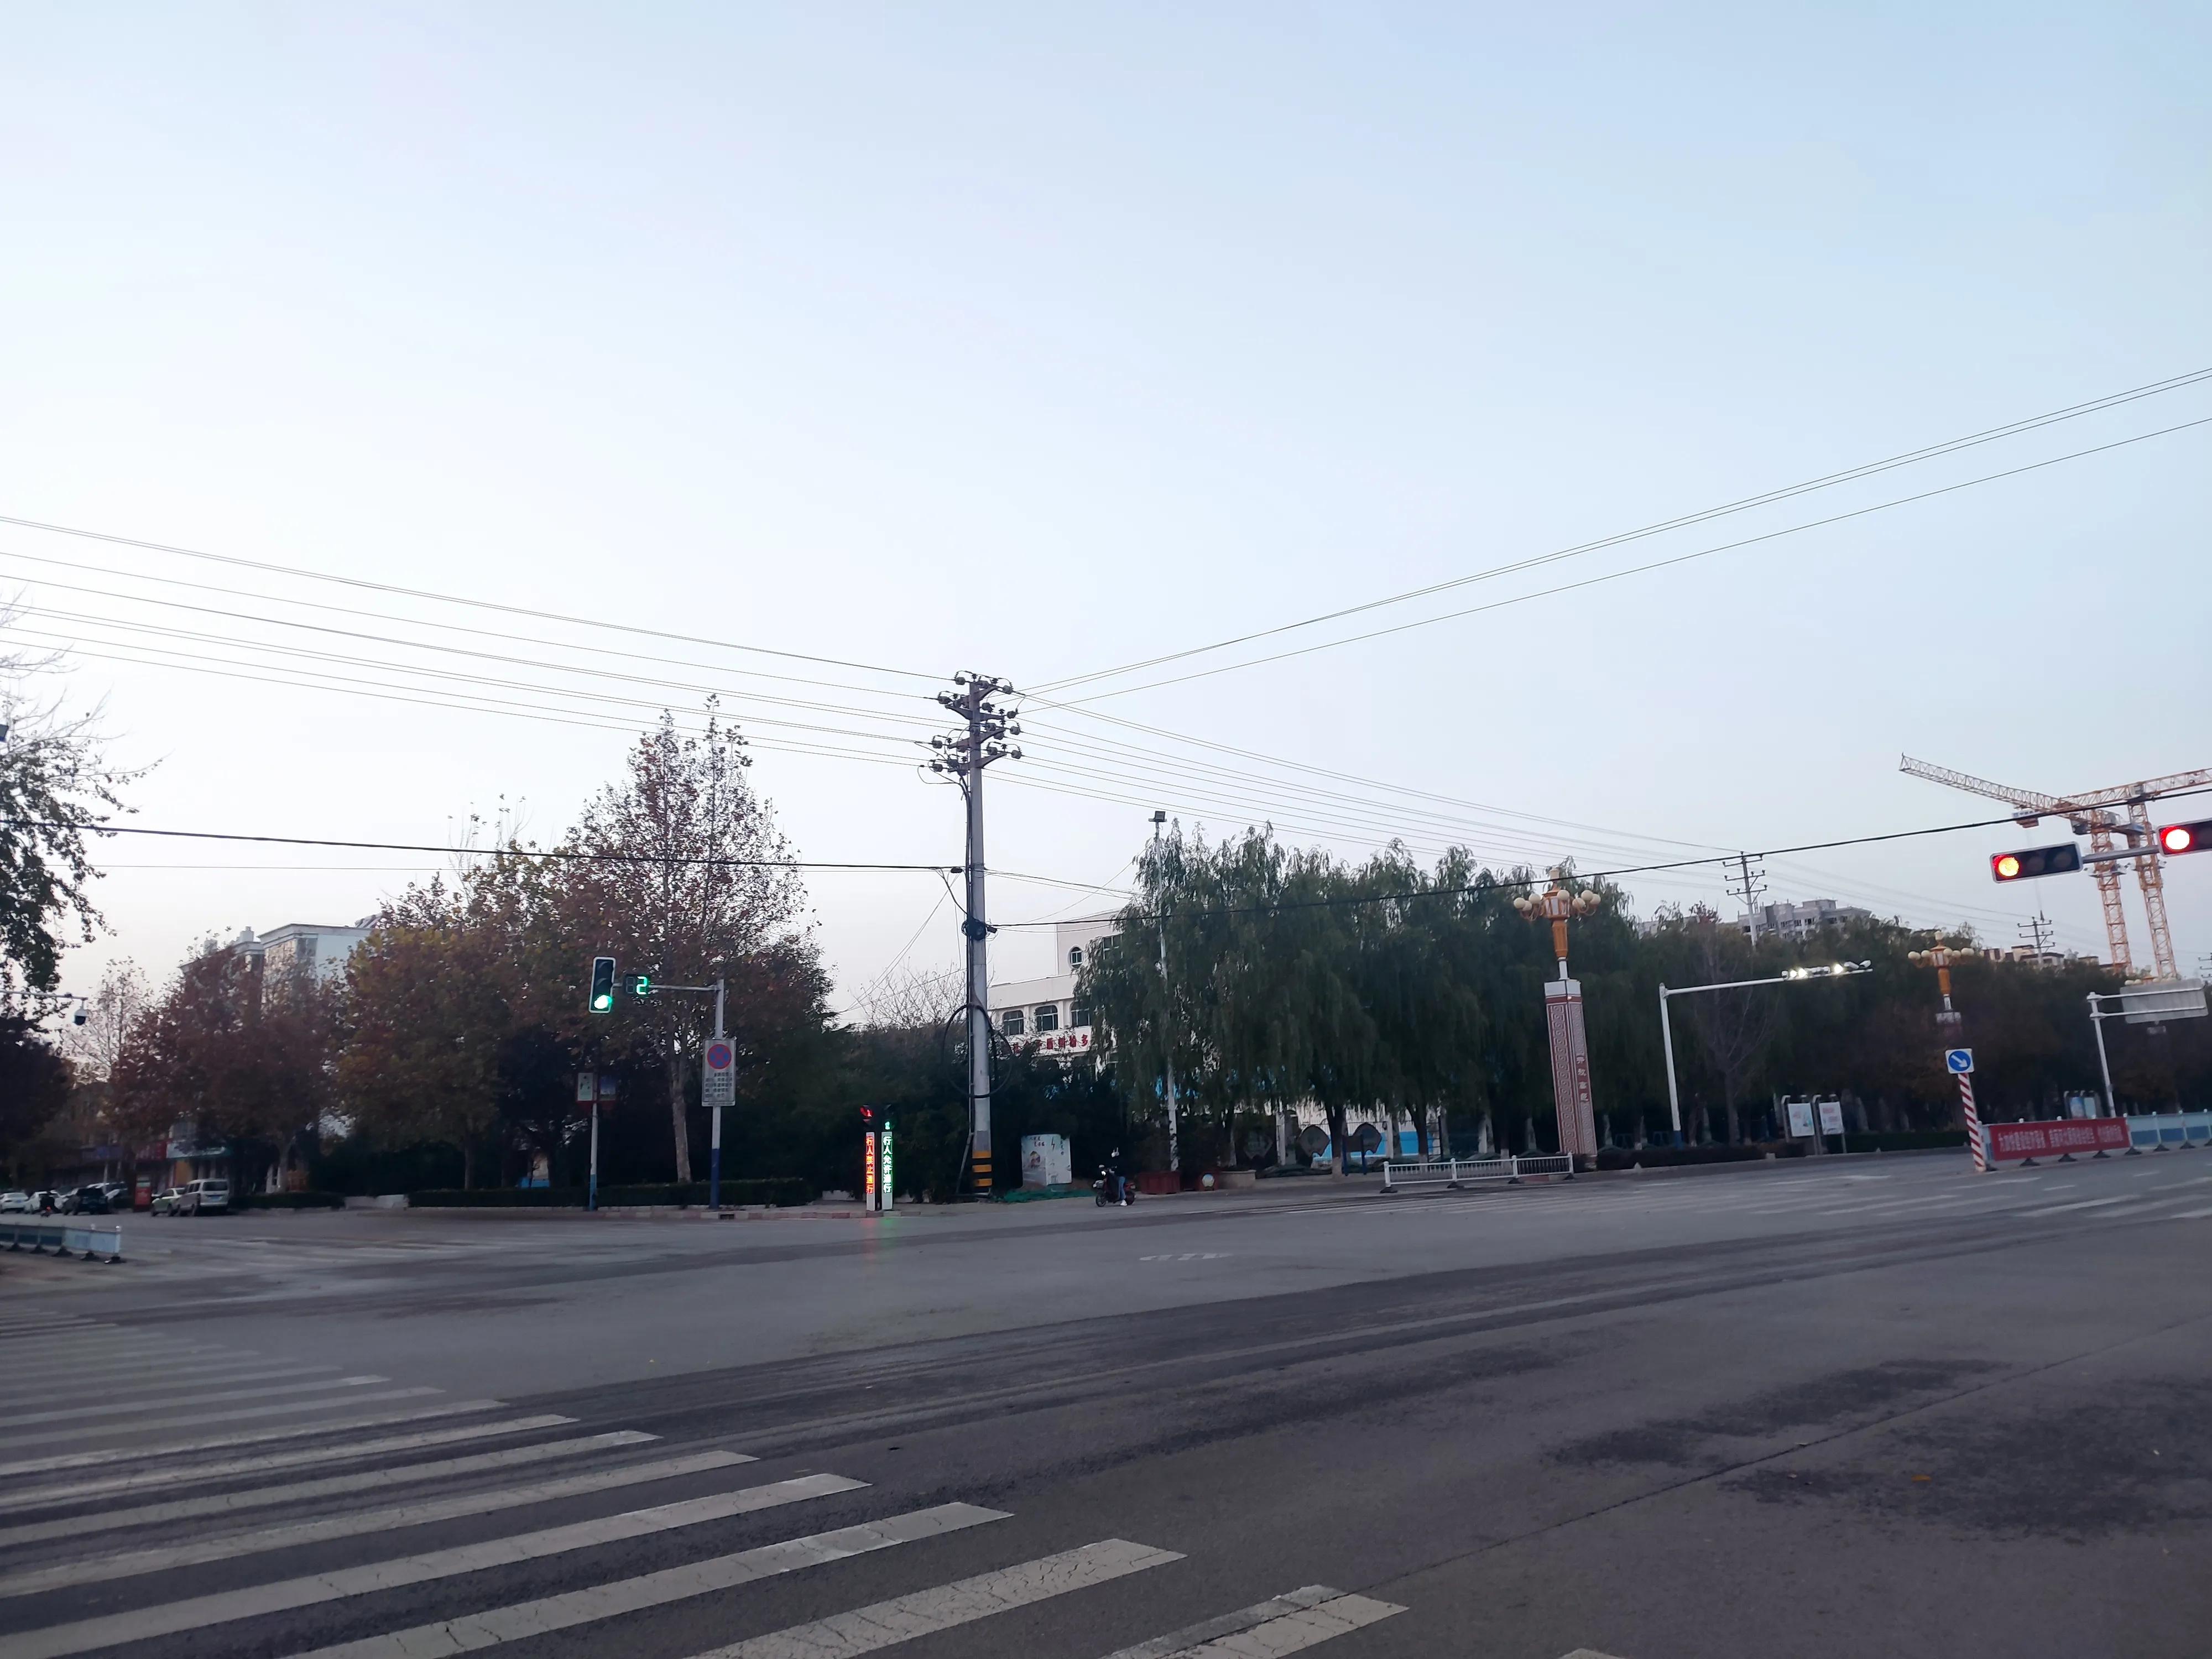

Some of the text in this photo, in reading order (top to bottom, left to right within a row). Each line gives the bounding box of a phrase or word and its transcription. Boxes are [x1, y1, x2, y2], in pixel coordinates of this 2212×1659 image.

[637, 976, 647, 994] 2
[883, 1136, 893, 1193] 行人允许通行
